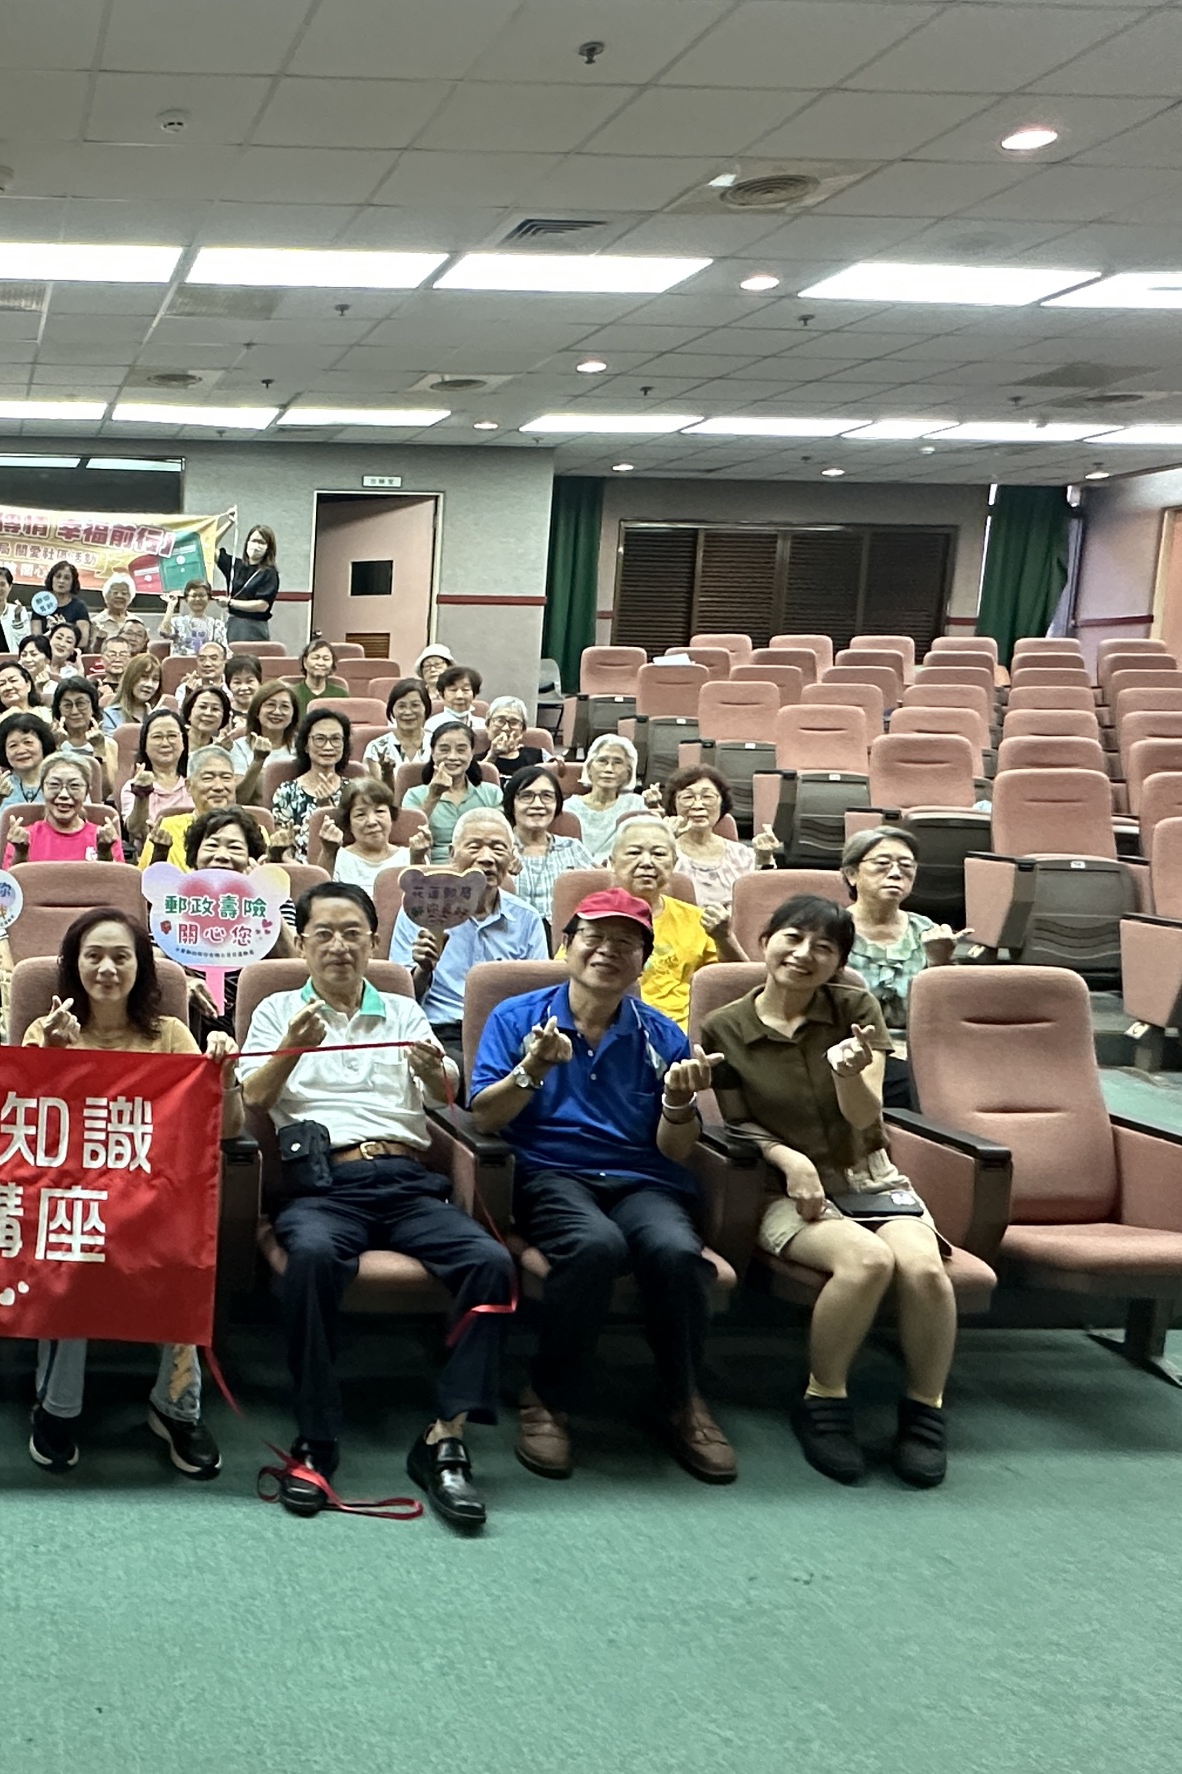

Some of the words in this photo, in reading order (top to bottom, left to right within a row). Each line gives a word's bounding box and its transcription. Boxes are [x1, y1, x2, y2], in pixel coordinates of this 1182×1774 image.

[165, 895, 267, 918] 郵政壽險
[179, 924, 252, 946] 關心您
